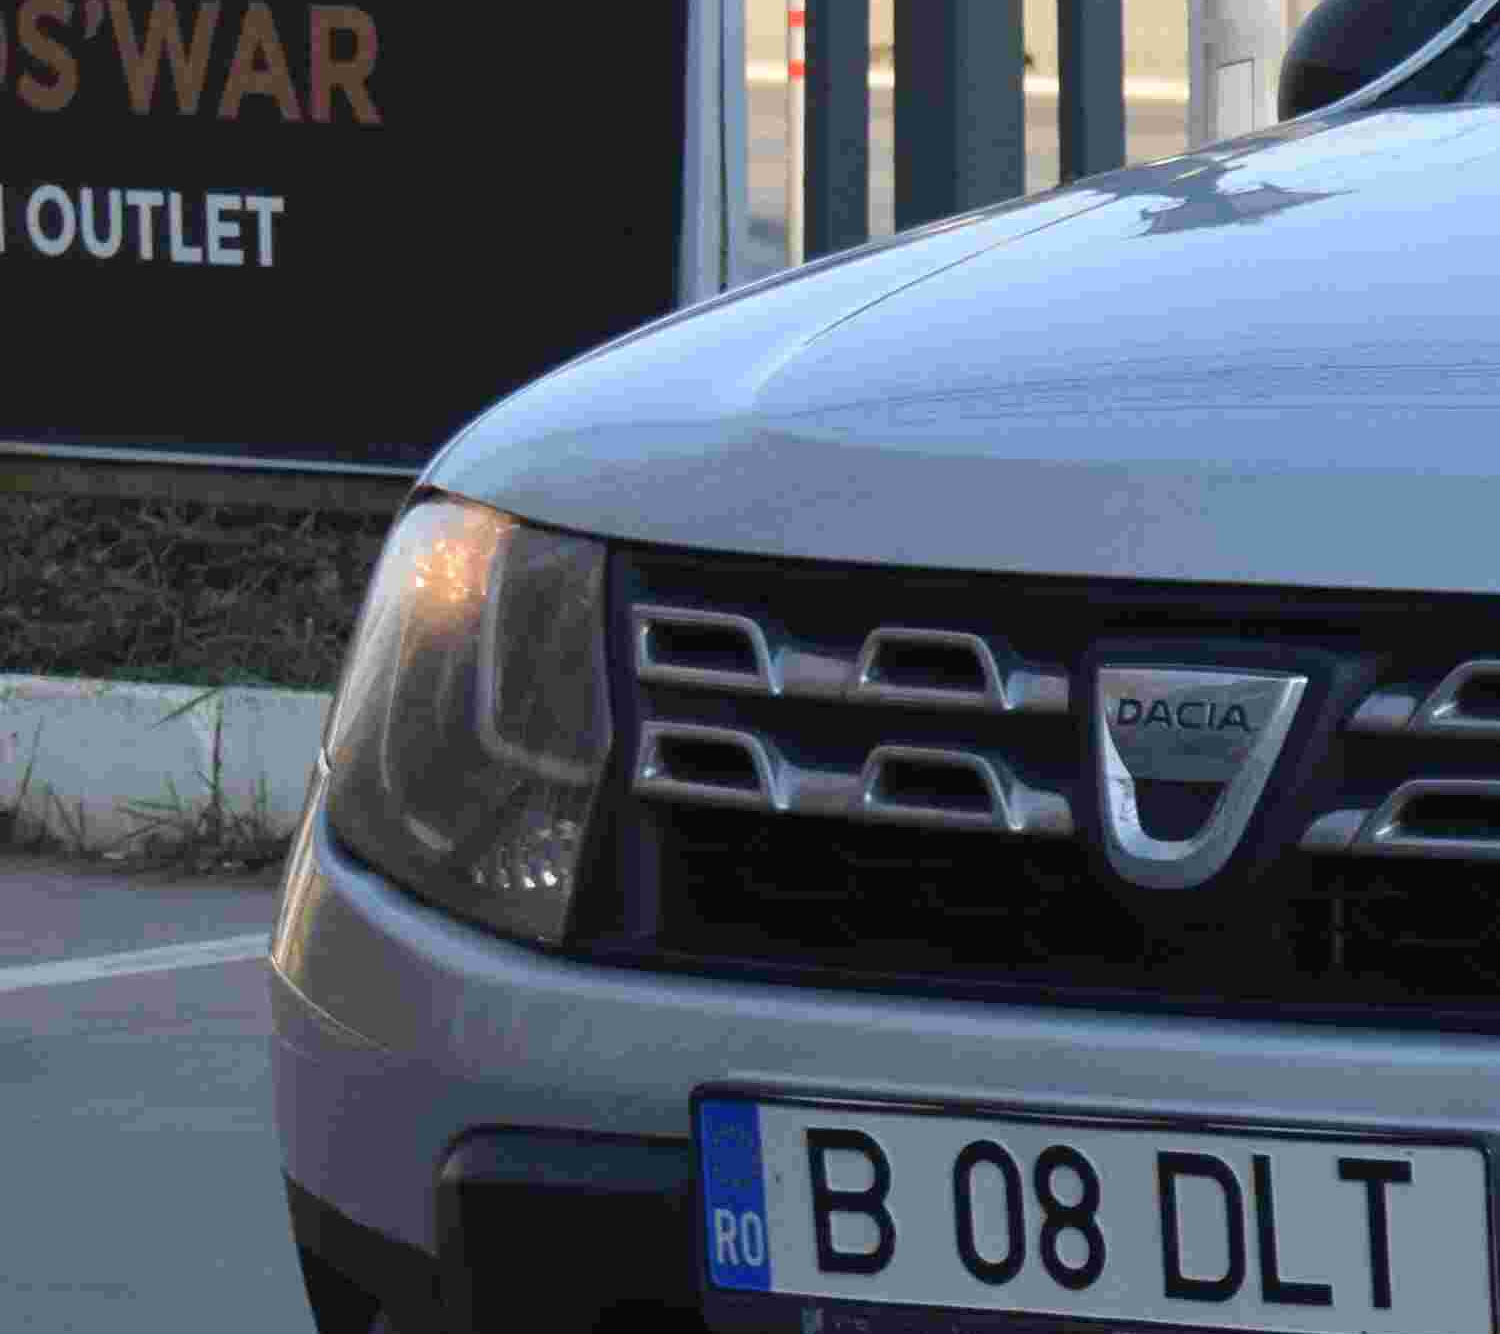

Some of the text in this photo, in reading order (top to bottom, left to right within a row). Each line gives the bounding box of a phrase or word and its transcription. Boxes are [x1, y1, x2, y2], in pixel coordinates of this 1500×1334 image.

[25, 183, 285, 268] OUTLET
[1116, 697, 1251, 733] DACIA
[715, 1208, 765, 1267] RO
[804, 1127, 1413, 1310] B 08 DLT
